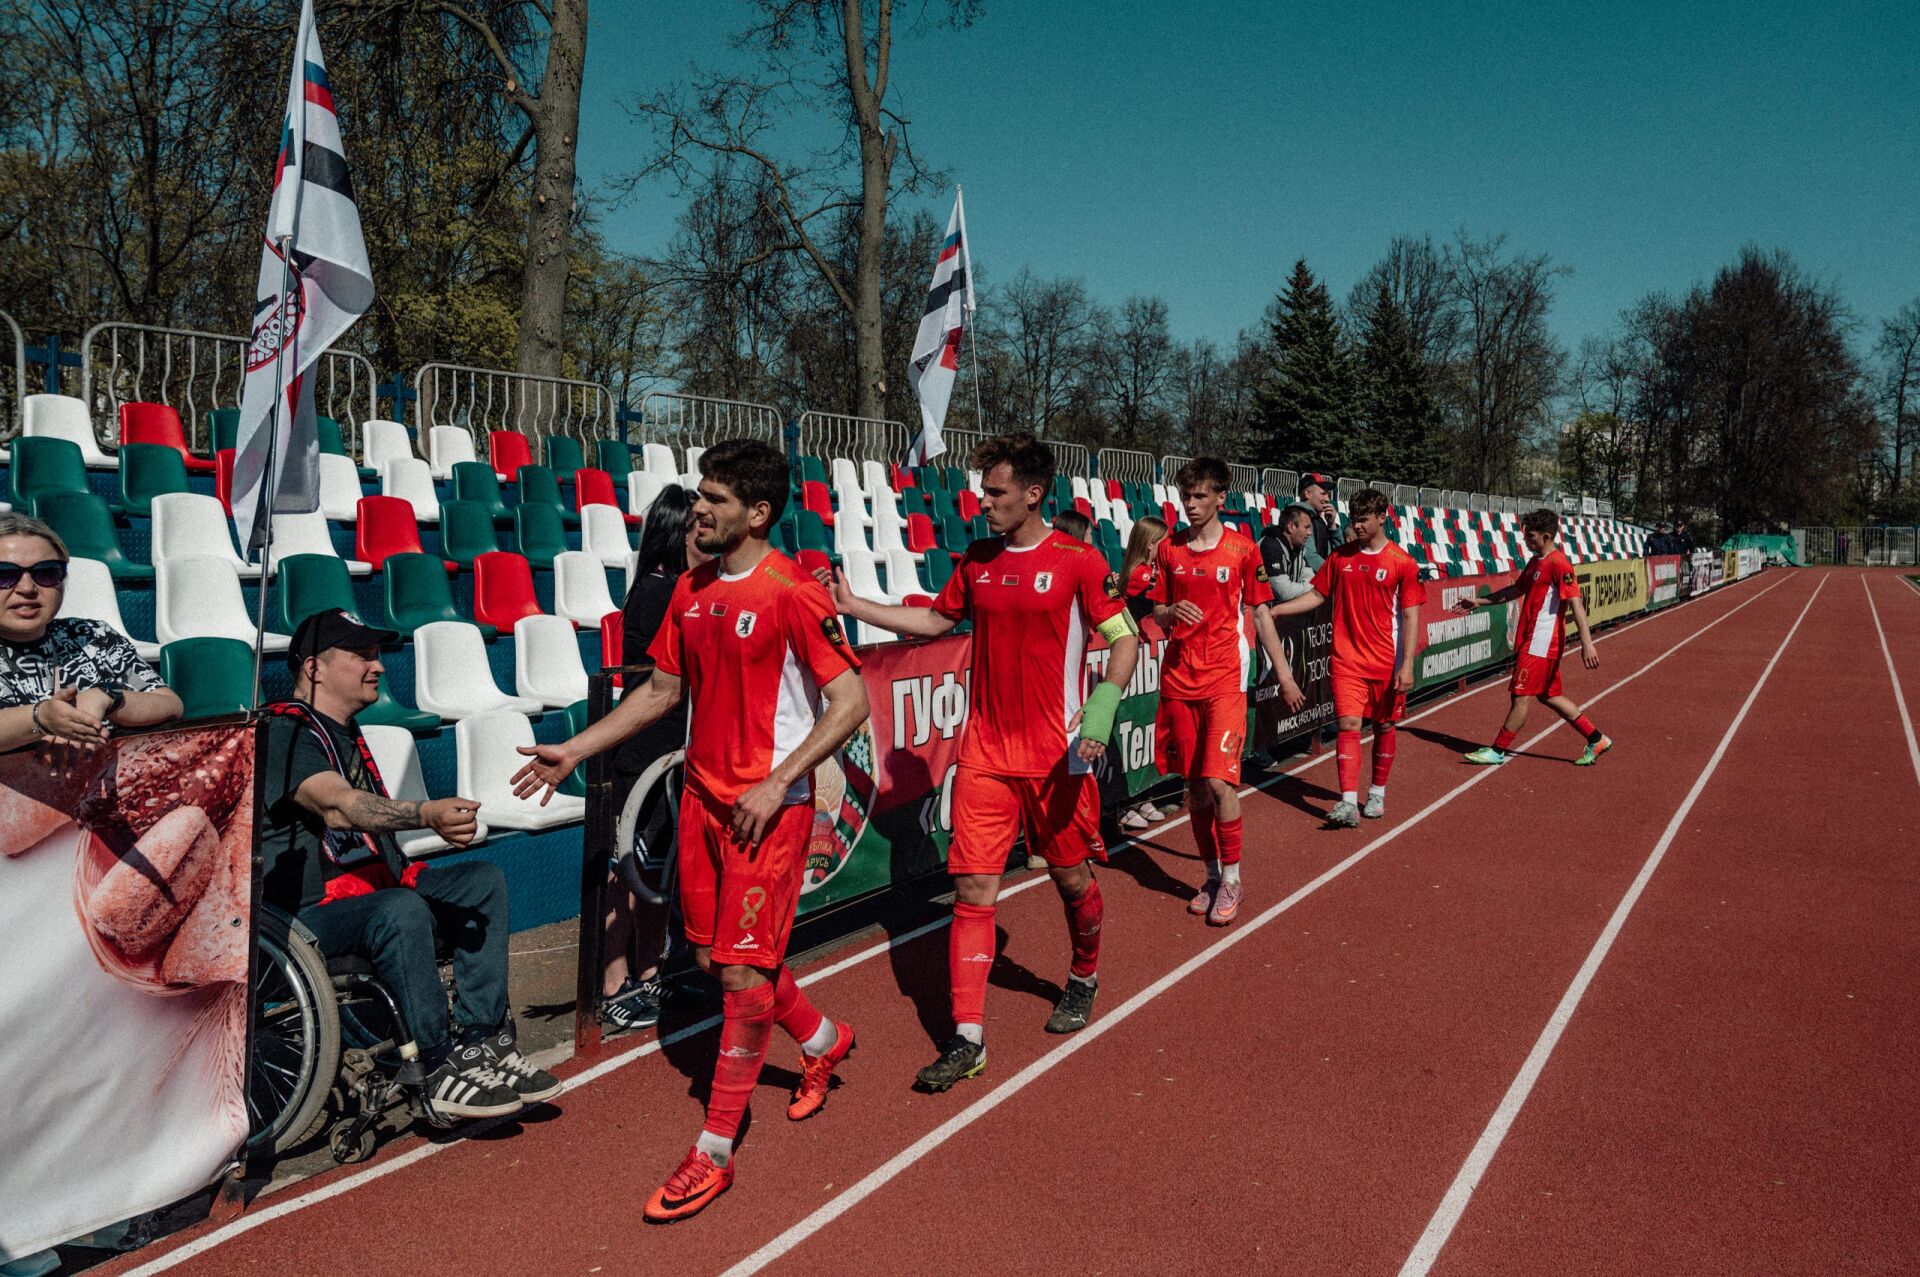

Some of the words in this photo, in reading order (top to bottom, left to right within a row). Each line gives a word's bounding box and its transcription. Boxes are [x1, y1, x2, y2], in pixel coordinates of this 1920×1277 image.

[1594, 573, 1621, 609] ПЕРВАЯ
[1307, 624, 1326, 648] ТВОЯ
[1307, 657, 1326, 682] ТВОЯ
[738, 886, 767, 930] 8
